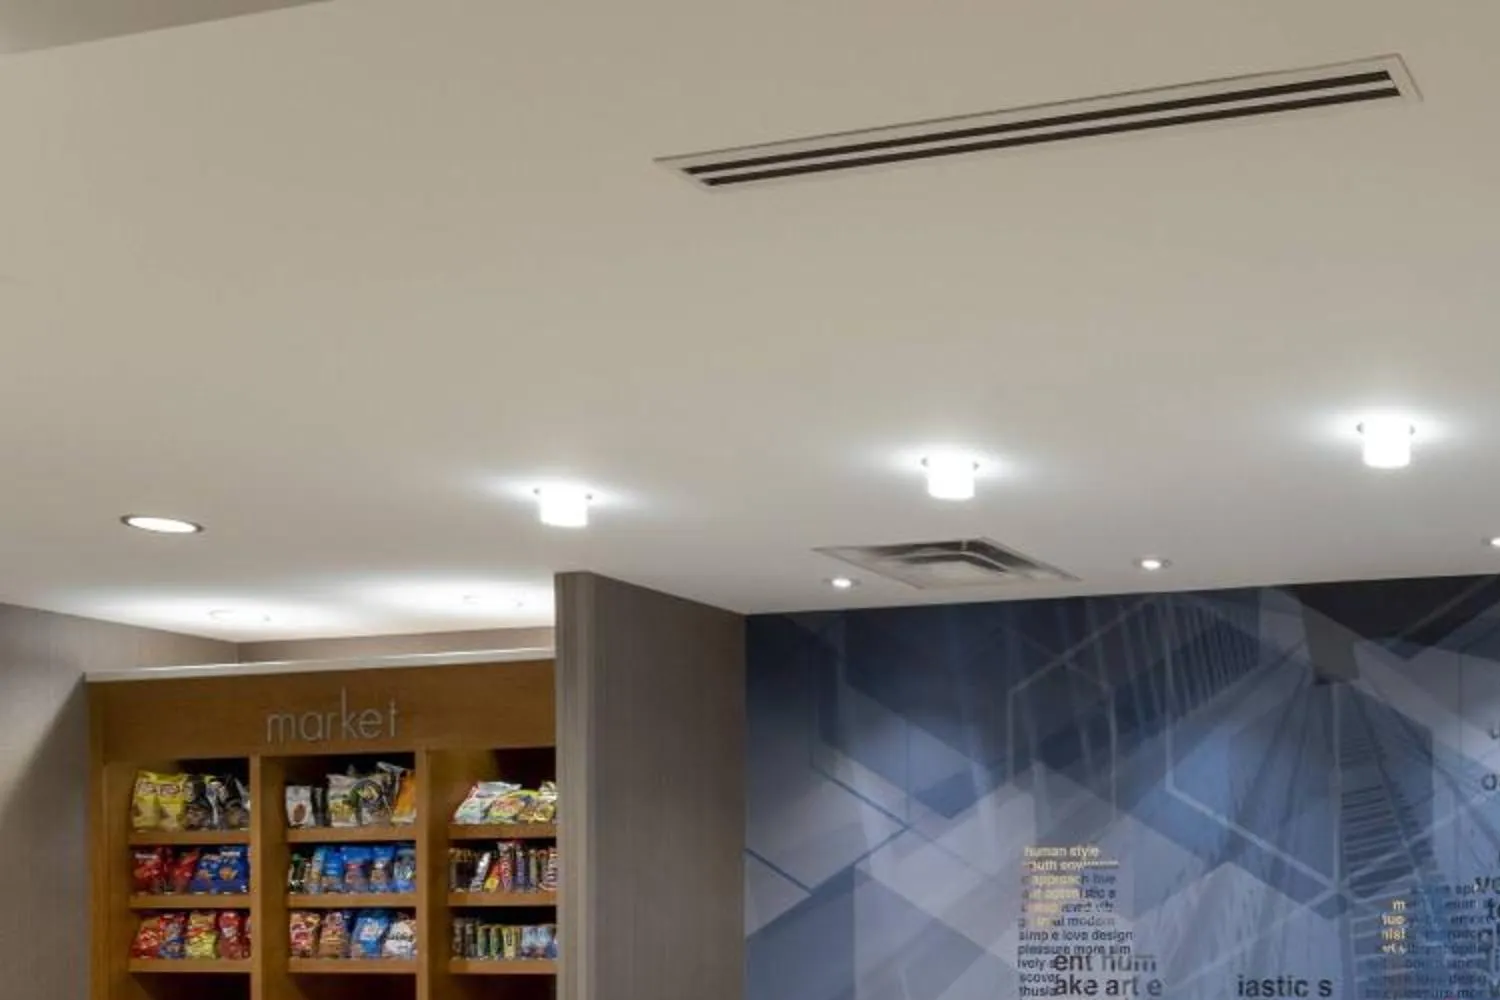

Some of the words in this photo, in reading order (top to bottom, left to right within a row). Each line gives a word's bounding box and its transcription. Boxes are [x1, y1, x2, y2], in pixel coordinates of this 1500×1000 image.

[266, 686, 401, 744] market
[1091, 930, 1133, 943] design
[1055, 974, 1099, 996] ake
[1105, 976, 1140, 996] art
[1237, 974, 1310, 998] iastic
[1318, 978, 1333, 998] s
